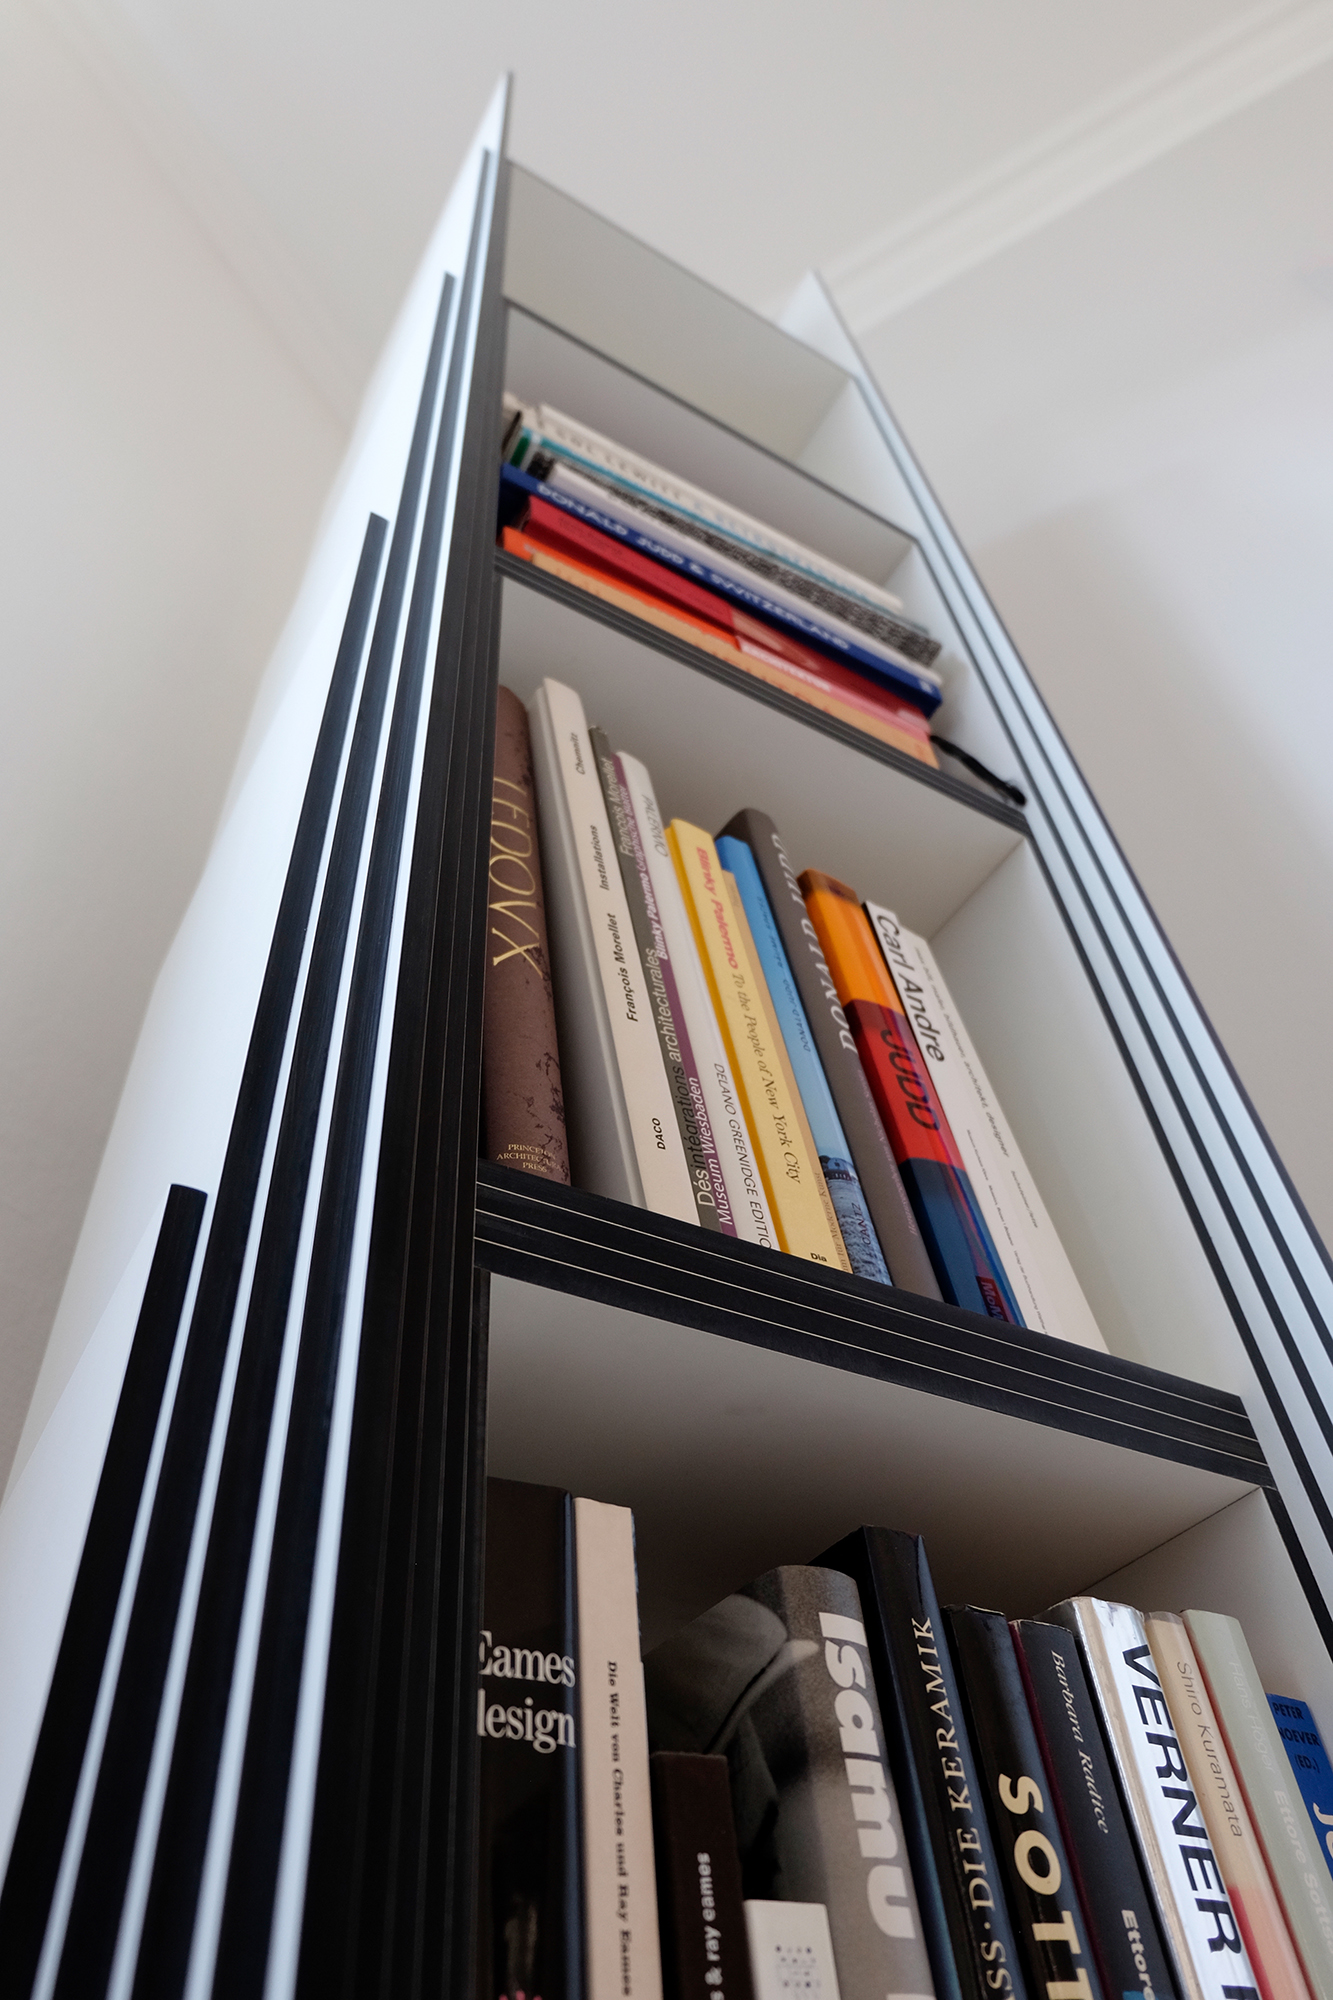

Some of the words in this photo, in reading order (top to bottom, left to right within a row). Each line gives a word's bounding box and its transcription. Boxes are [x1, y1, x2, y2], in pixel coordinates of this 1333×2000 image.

[536, 482, 629, 536] DONALD
[636, 535, 684, 565] JUDD
[689, 557, 705, 576] &
[710, 572, 849, 650] SWITZERLAND
[569, 732, 586, 775] Chemnitz
[601, 757, 621, 803] Morellet
[590, 824, 610, 891] Installations
[696, 847, 717, 896] Blinky
[640, 872, 659, 920] Palermo
[607, 913, 627, 964] Morellet
[651, 920, 668, 961] Blinky
[710, 898, 738, 970] Palermo
[618, 966, 639, 1022] François
[641, 794, 669, 857] PALERMO
[714, 1063, 737, 1115] DELANO
[729, 1119, 759, 1197] GREENIDGE
[732, 972, 746, 989] To
[737, 985, 750, 1012] the
[782, 979, 797, 1009] JUDD
[800, 918, 858, 1054] DONALD
[877, 914, 914, 971] Carl
[898, 972, 945, 1062] Andre
[646, 947, 682, 1063] architecturales
[744, 1013, 765, 1060] People
[792, 1008, 811, 1053] DONALD
[757, 1060, 772, 1078] of
[881, 1029, 940, 1131] JUDD
[688, 1077, 714, 1154] Wiesbaden
[762, 1077, 780, 1109] New
[508, 1143, 556, 1160] PRINCETON
[651, 1117, 666, 1151] DACO
[673, 1066, 716, 1207] Désintégrations
[772, 1113, 793, 1148] York
[986, 1111, 1010, 1158] designer
[496, 1152, 563, 1171] ARCHITECTURA
[522, 1161, 548, 1172] PRESS
[783, 1151, 801, 1184] City
[707, 1158, 733, 1225] Museum
[810, 1252, 828, 1262] Dia
[607, 1660, 617, 1687] Die
[609, 1693, 620, 1728] Welt
[911, 1616, 974, 1814] KERAMIK
[1272, 1701, 1304, 1720] PETER
[610, 1733, 621, 1763] von
[1051, 1650, 1085, 1743] Barbara
[1077, 1749, 1109, 1834] Radice
[1176, 1661, 1203, 1717] Shiro
[1197, 1724, 1243, 1838] Kuramata
[1278, 1727, 1320, 1747] NOEVER
[818, 1611, 917, 1940] Isamu
[1228, 1661, 1252, 1709] Hans
[1248, 1715, 1276, 1774] Höger
[1274, 1790, 1307, 1864] Ettore
[1294, 1754, 1321, 1774] (ED.)
[612, 1768, 625, 1836] Charles
[1122, 1643, 1243, 1955] VERNER
[616, 1842, 629, 1877] und
[956, 1826, 996, 1911] DIE
[616, 1884, 629, 1922] Ray
[697, 1852, 717, 1922] eames
[619, 1929, 632, 1997] Eames
[704, 1925, 722, 1962] ray
[1121, 1909, 1156, 2000] Ettore
[980, 1940, 1016, 2000] SS
